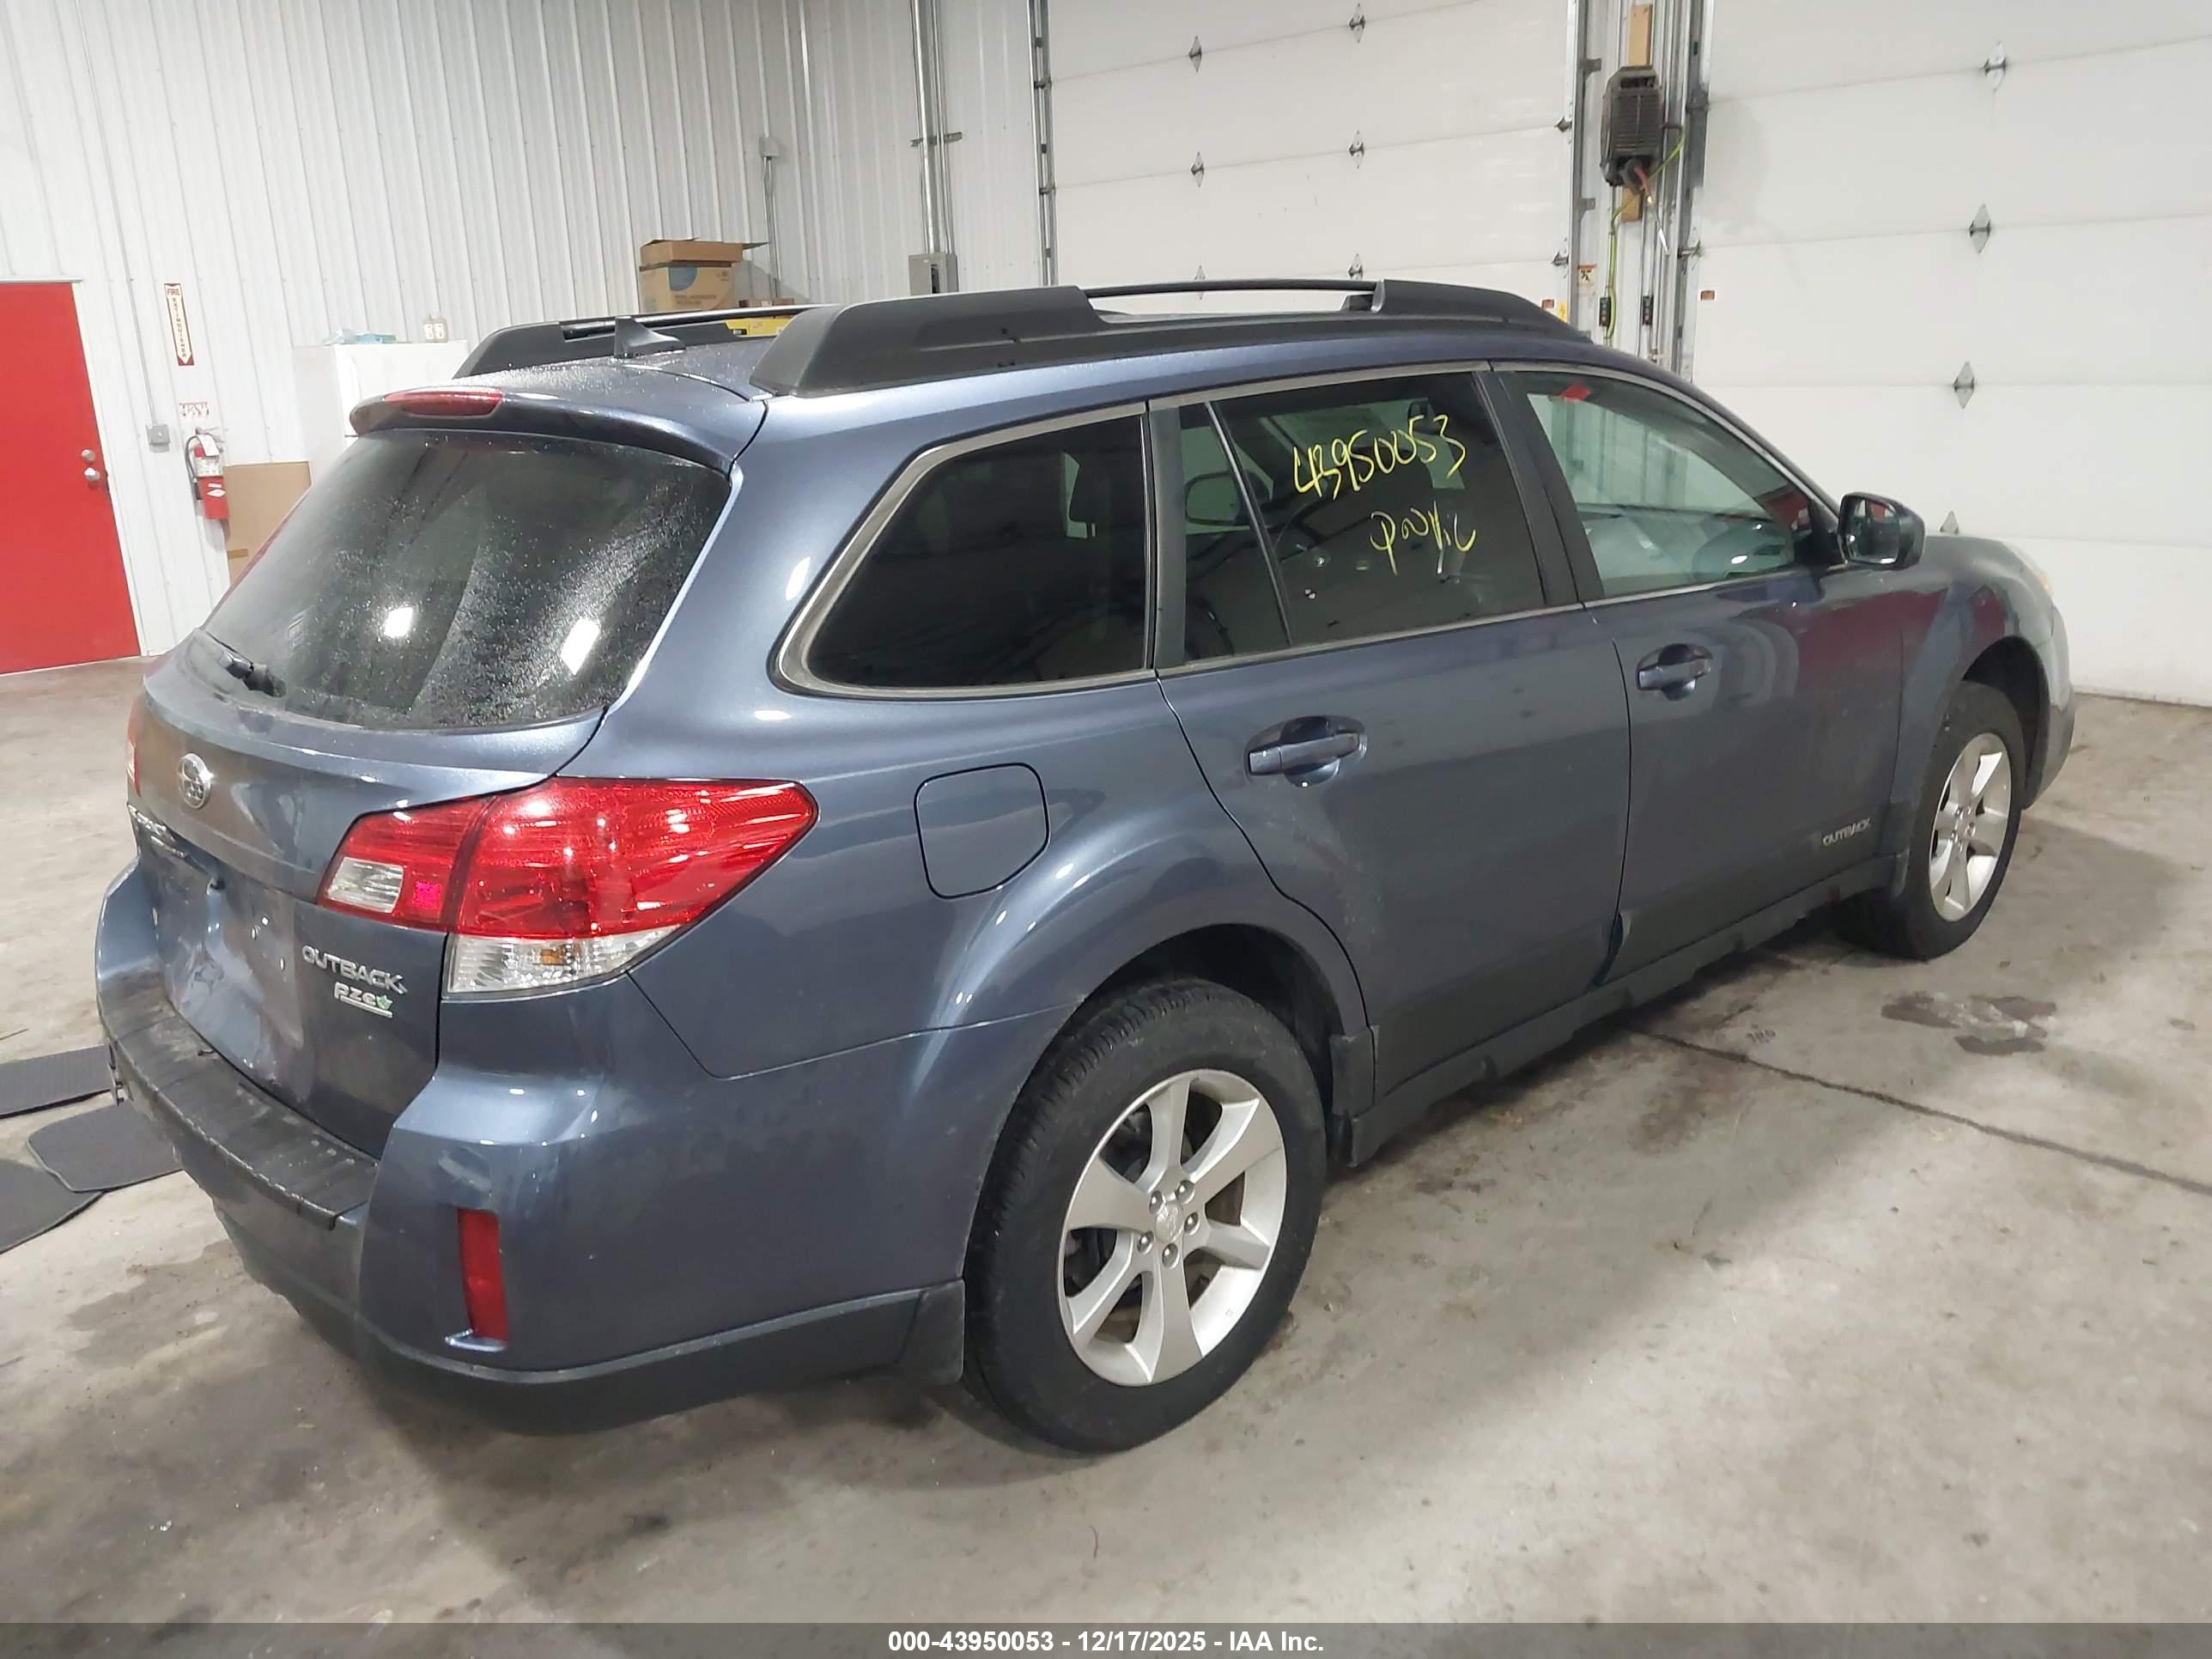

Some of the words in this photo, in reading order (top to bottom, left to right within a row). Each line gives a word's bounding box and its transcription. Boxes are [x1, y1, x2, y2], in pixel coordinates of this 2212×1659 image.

[1293, 414, 1466, 501] 43950053
[1822, 817, 1871, 847] OUTBACK
[301, 945, 408, 994] OUTBACK
